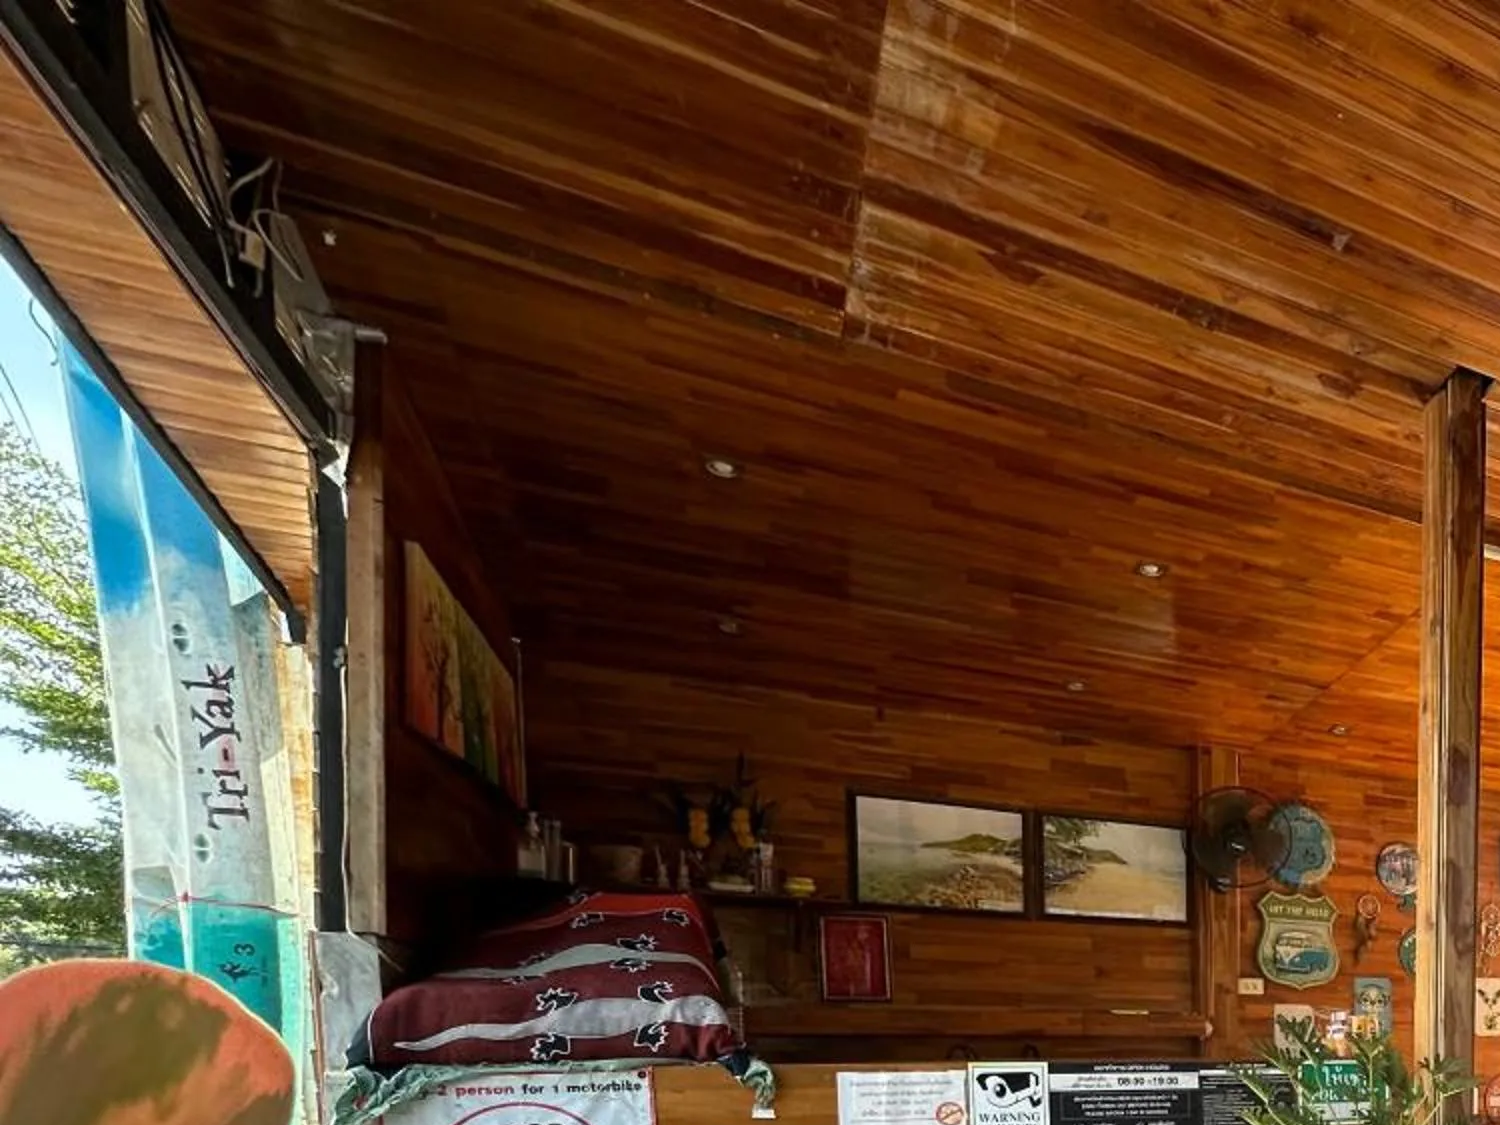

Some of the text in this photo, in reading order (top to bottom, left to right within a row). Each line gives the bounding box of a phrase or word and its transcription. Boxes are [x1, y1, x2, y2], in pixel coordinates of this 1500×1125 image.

[180, 663, 250, 831] Tri-Yak
[455, 1085, 514, 1098] person
[522, 1083, 545, 1096] for
[566, 1080, 642, 1095] motorbike
[979, 1112, 1041, 1123] WARNING
